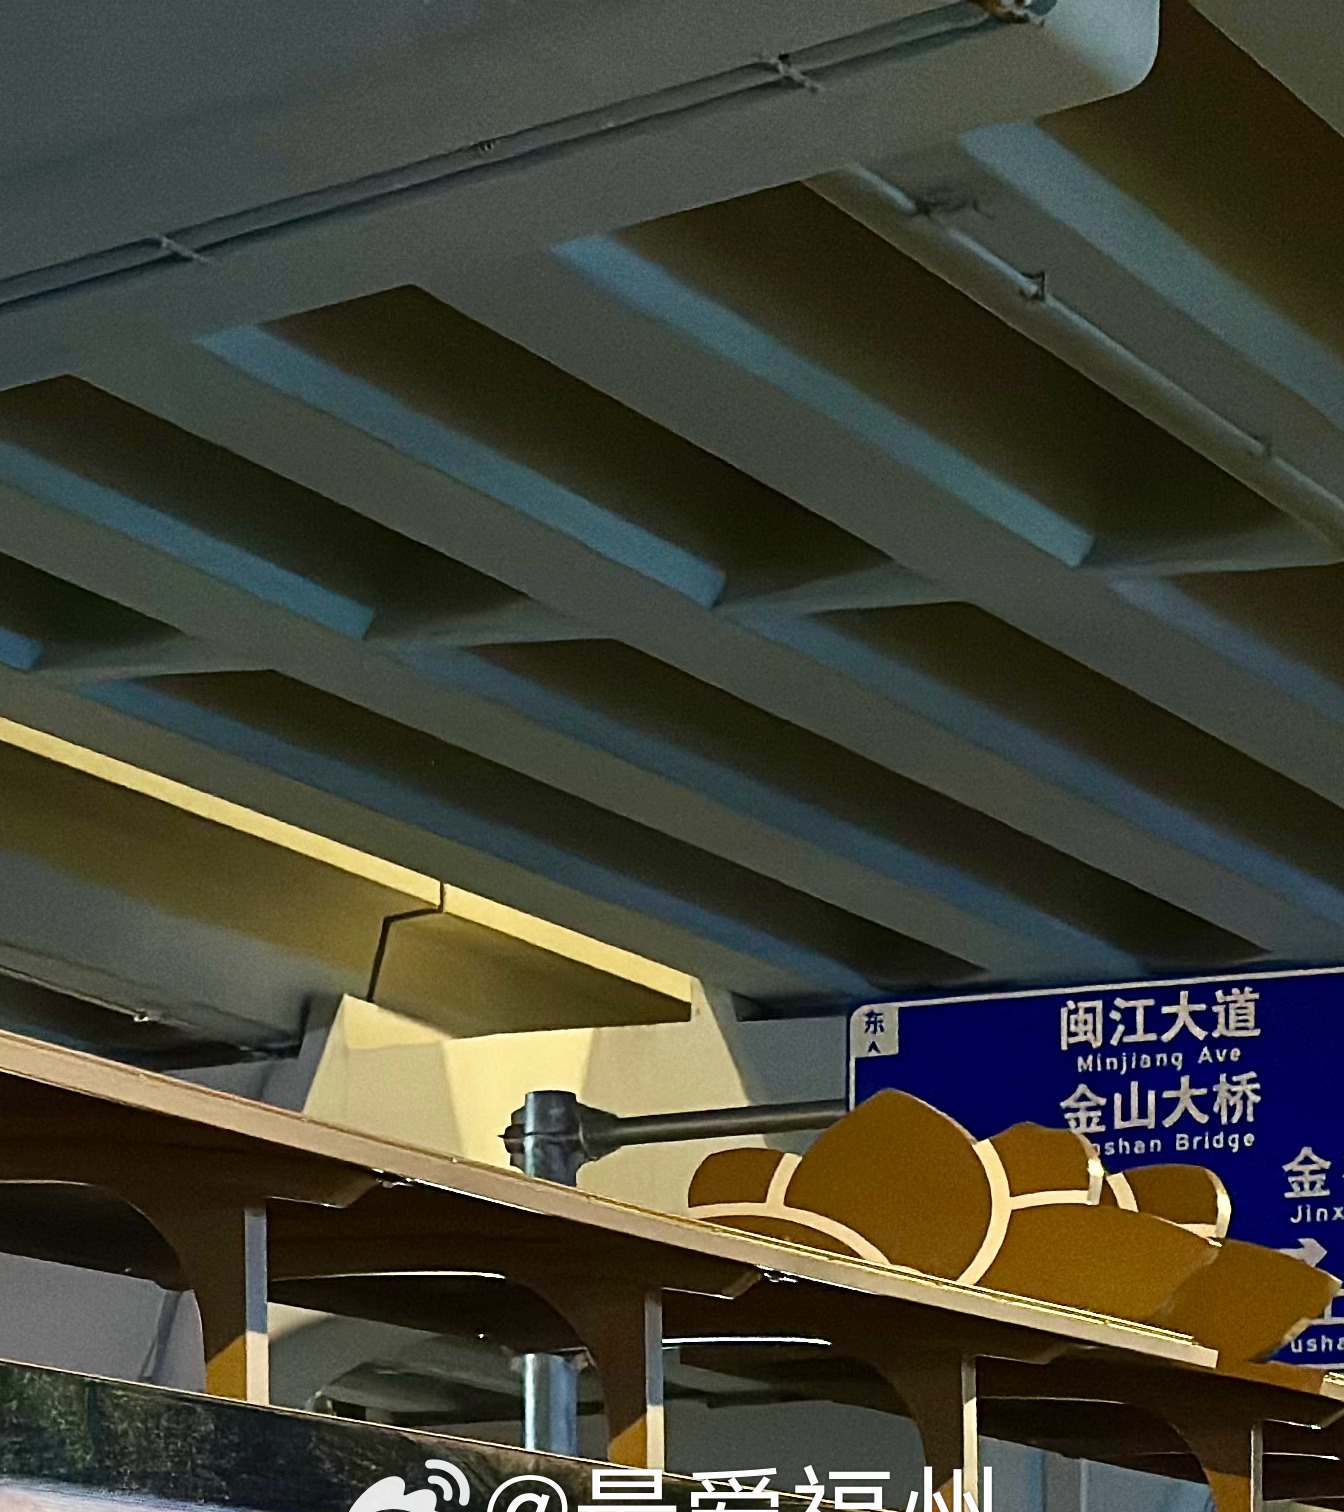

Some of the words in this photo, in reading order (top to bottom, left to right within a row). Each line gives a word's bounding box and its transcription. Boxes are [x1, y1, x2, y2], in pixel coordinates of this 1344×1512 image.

[863, 1009, 885, 1035] 东
[1059, 986, 1261, 1051] 闽江大道
[1076, 1051, 1183, 1075] Minjiang
[1197, 1045, 1242, 1065] Ave
[1059, 1071, 1262, 1134] 金山大桥
[1092, 1137, 1162, 1156] shan
[1175, 1131, 1255, 1153] Bridge
